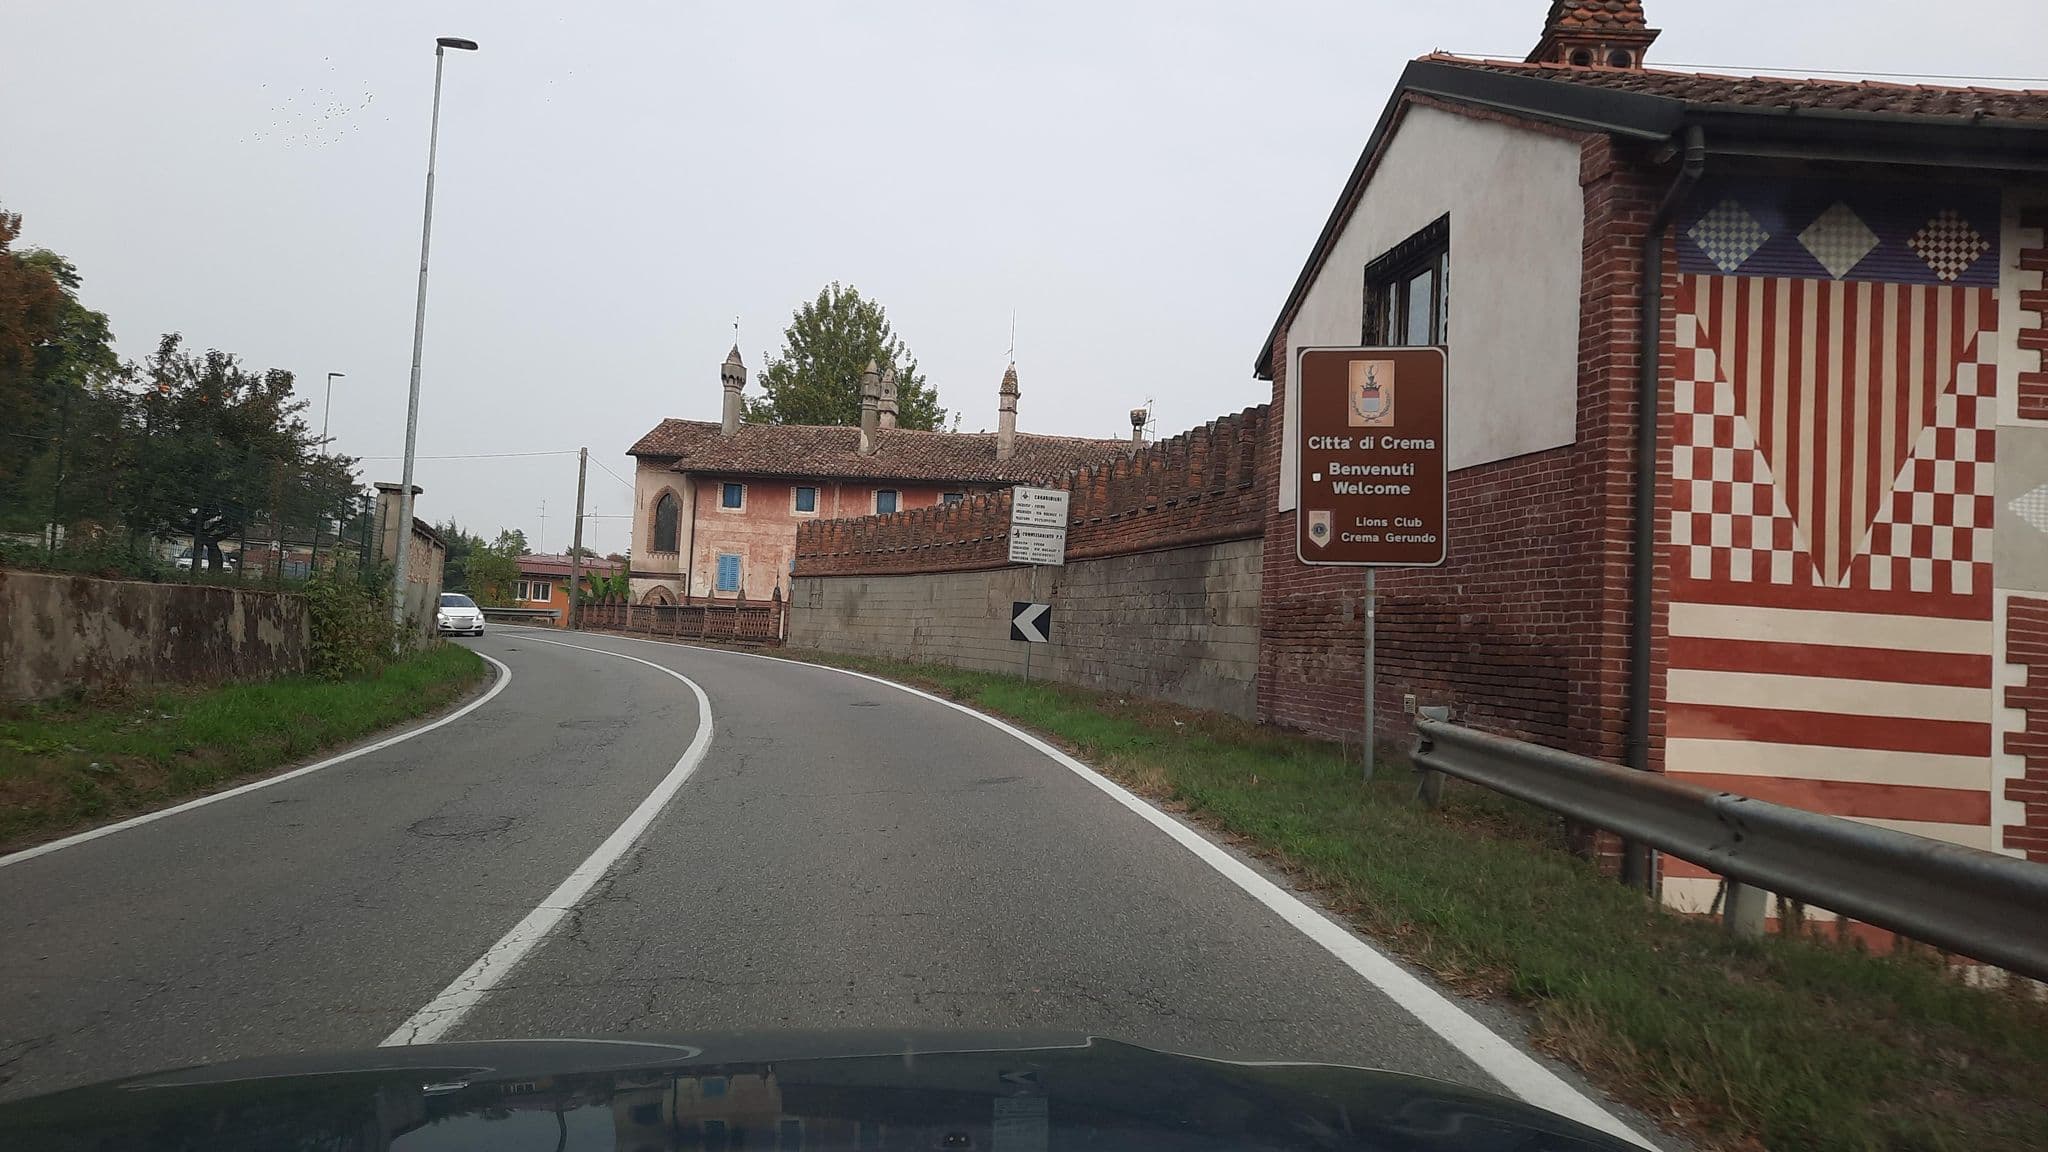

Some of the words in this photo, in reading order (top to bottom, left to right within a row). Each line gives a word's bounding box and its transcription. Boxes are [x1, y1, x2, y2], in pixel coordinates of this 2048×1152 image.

[1359, 436, 1375, 450] di
[1380, 436, 1436, 450] Crema
[1328, 462, 1415, 476] Benvenuti
[1332, 481, 1411, 495] Welcome
[1355, 516, 1389, 528] Lions
[1394, 517, 1423, 528] Club
[1341, 532, 1380, 543] Crema
[1385, 532, 1437, 544] Gerundo
